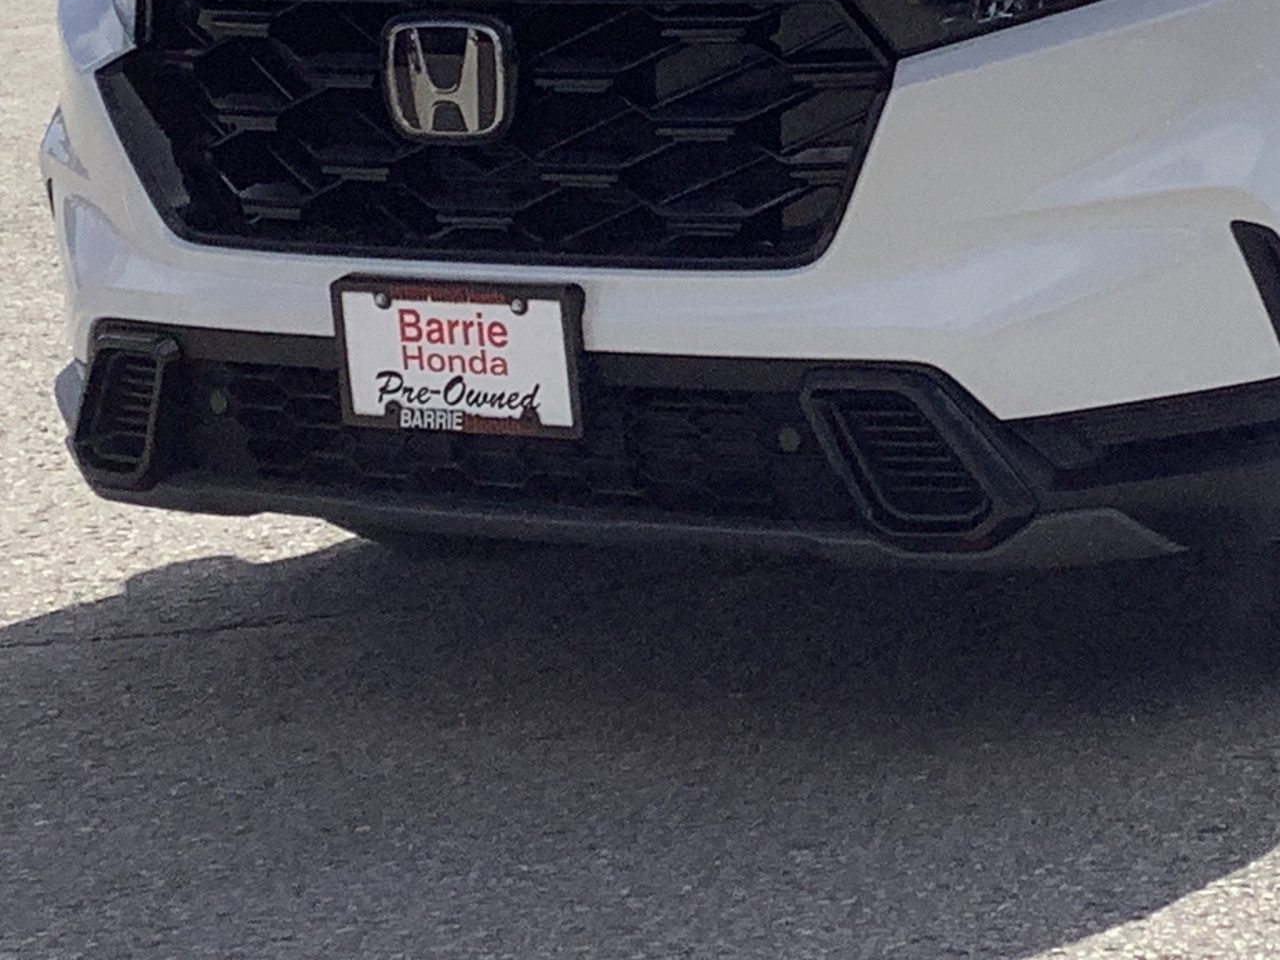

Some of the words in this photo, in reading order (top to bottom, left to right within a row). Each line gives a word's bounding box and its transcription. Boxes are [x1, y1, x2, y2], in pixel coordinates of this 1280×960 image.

[397, 308, 509, 347] Barrie
[401, 344, 509, 376] Honda
[375, 370, 540, 412] Pre-Owned
[399, 407, 464, 431] BARRIE
